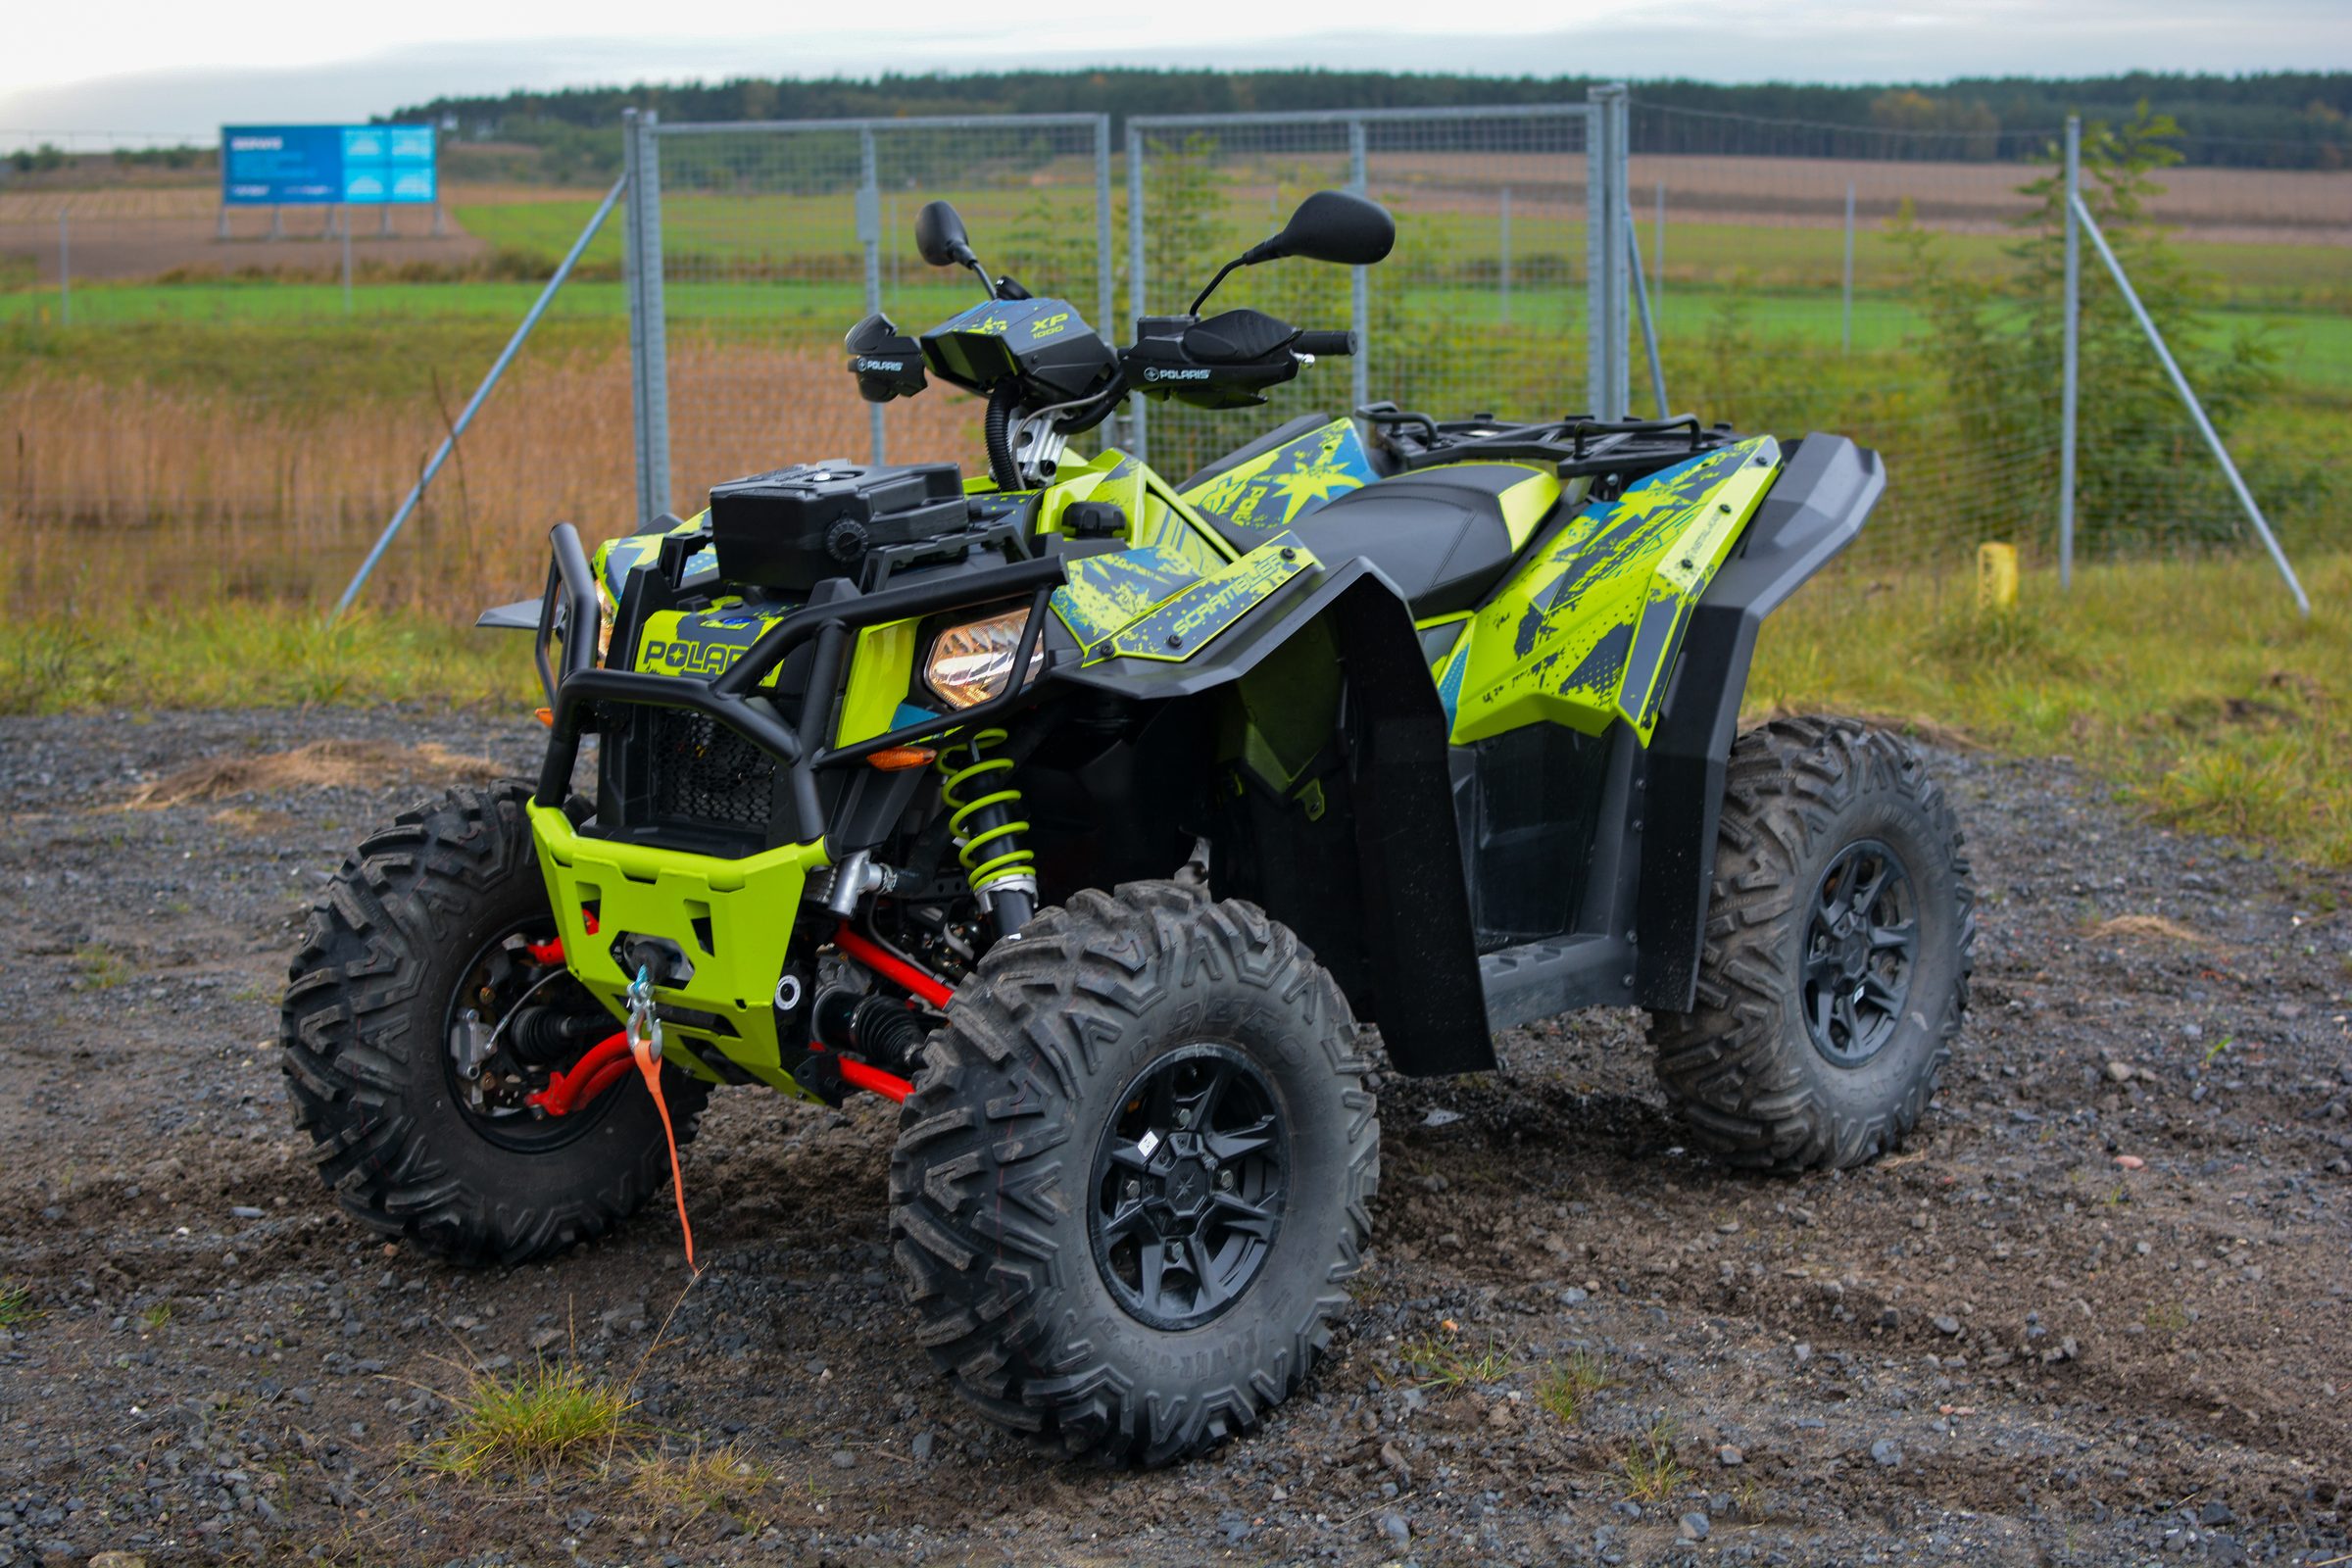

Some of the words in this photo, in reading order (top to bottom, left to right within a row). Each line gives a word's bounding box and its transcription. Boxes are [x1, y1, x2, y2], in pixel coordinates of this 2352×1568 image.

[1030, 313, 1069, 333] XP
[1033, 324, 1064, 340] 1000
[866, 360, 904, 372] POLARIS
[1159, 368, 1211, 380] POLARIS
[1568, 509, 1675, 592] POLARIS
[1173, 552, 1283, 637] SCRAMBLER
